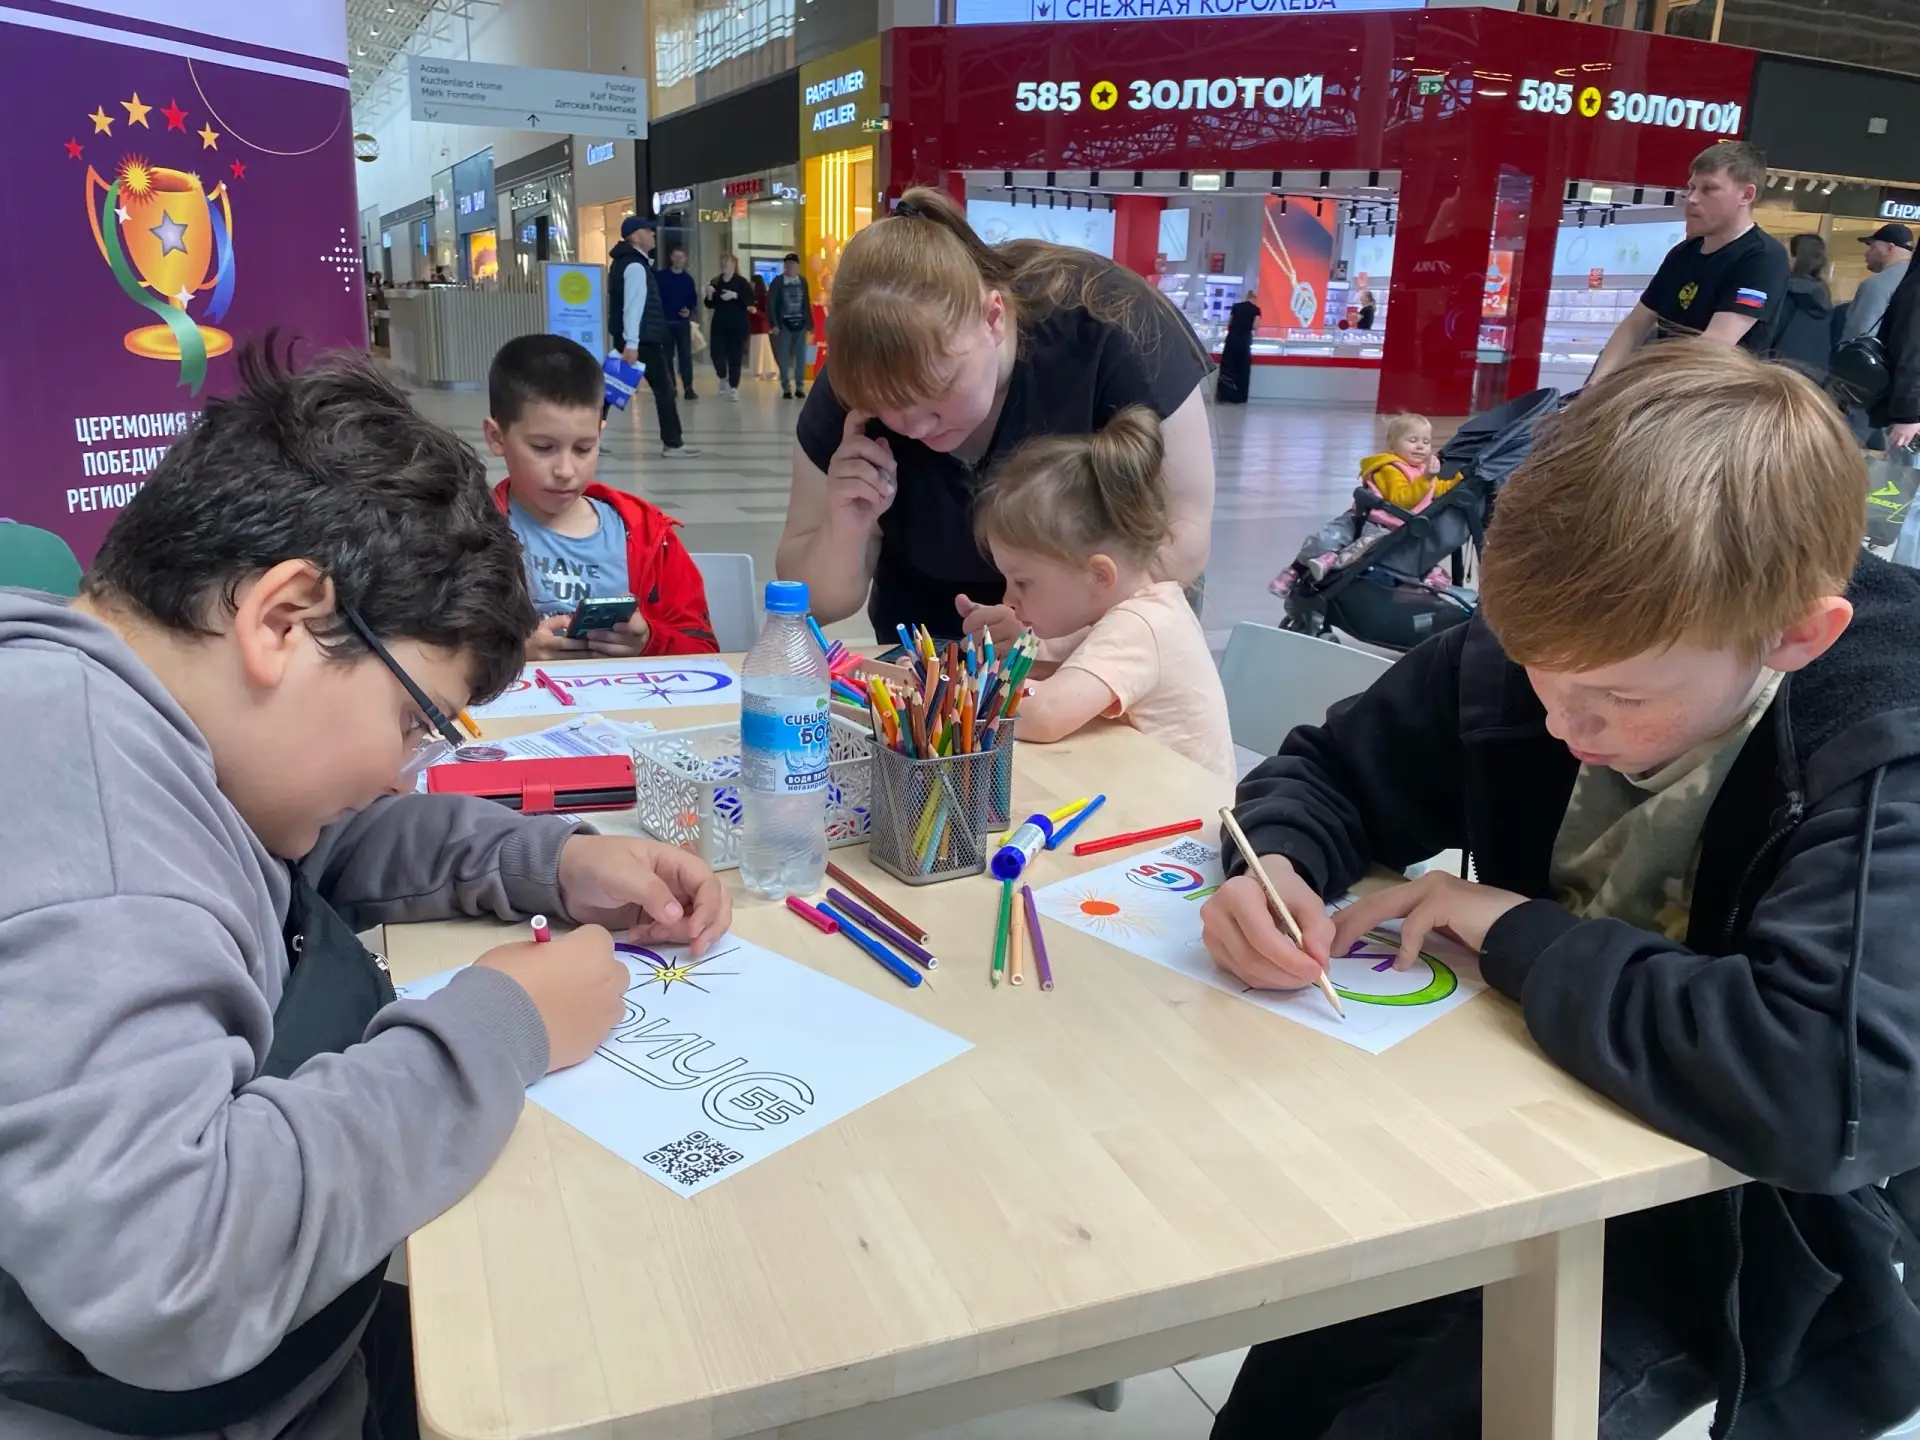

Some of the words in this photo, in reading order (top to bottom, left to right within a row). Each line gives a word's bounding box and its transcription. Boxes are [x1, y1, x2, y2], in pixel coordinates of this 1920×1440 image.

[1066, 0, 1189, 18] СНЕЖНАЯ
[420, 63, 450, 75] Acoola
[420, 76, 473, 89] Kuchenland
[476, 81, 503, 92] Home
[421, 87, 444, 98] Mark
[447, 89, 487, 102] Formelle
[605, 82, 636, 94] Funday
[805, 69, 865, 105] PARFUMER
[1015, 81, 1081, 112] 585
[1128, 74, 1323, 110] ЗОЛОТОЙ
[554, 99, 590, 111] Детская
[592, 102, 637, 115] Галактика
[813, 102, 856, 132] ATELIER
[1518, 79, 1574, 115] 585
[1605, 90, 1742, 135] ЗОЛОТОЙ
[75, 411, 188, 446] ЦЕРЕМОНИЯ
[83, 444, 172, 477] ПОБЕДИТ
[533, 556, 600, 579] HAVE
[540, 579, 591, 601] FUN
[729, 1086, 805, 1125] 55
